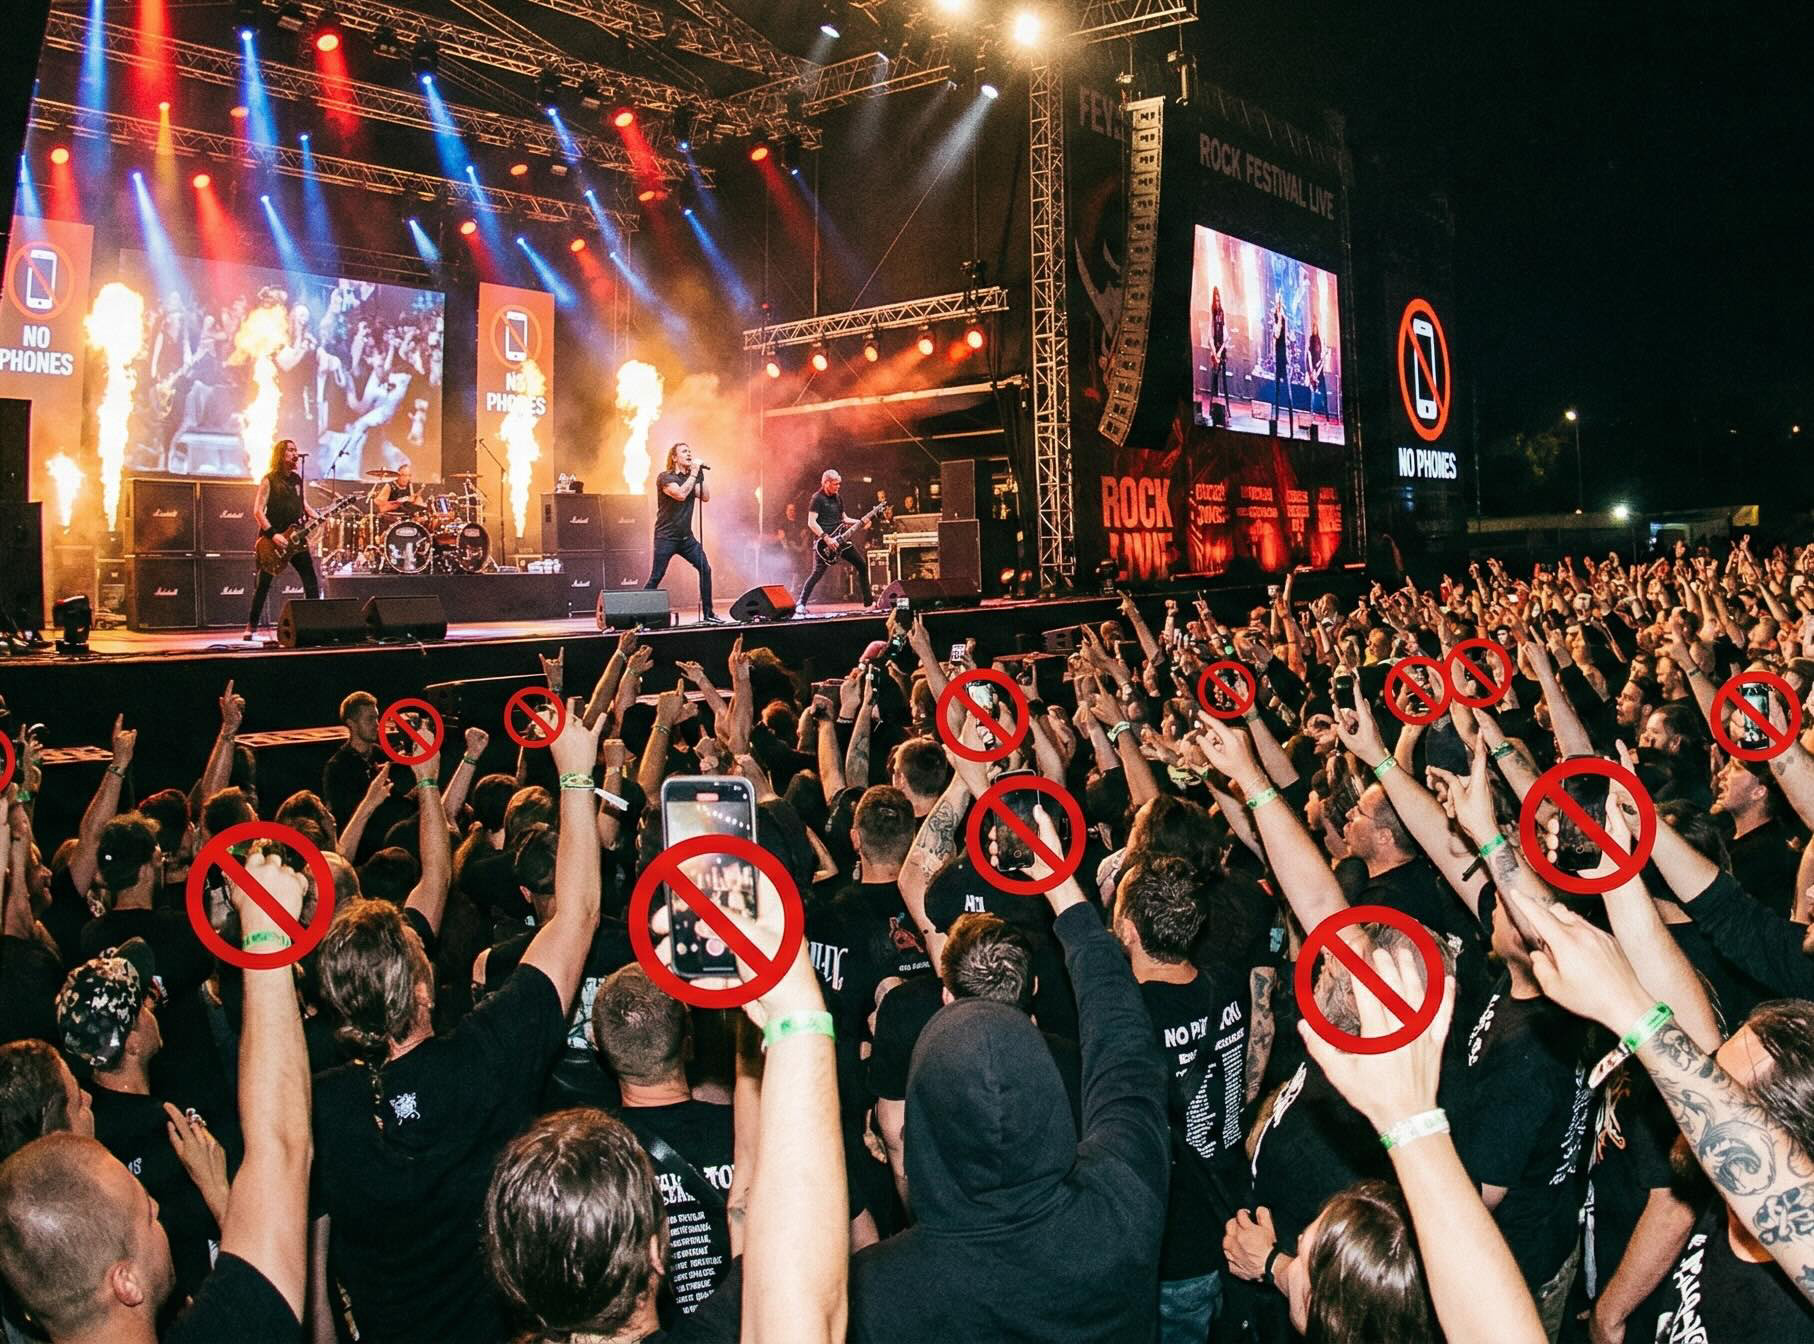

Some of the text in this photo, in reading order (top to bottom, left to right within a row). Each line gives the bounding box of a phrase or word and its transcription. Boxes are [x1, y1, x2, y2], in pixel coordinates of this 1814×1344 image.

[1200, 132, 1335, 220] ROCK FESTIVAL LIVE
[23, 325, 51, 349] NO
[0, 348, 75, 376] PHONES
[1398, 447, 1457, 480] NO PHONES
[1101, 475, 1174, 529] ROCK
[1164, 1027, 1190, 1048] NO
